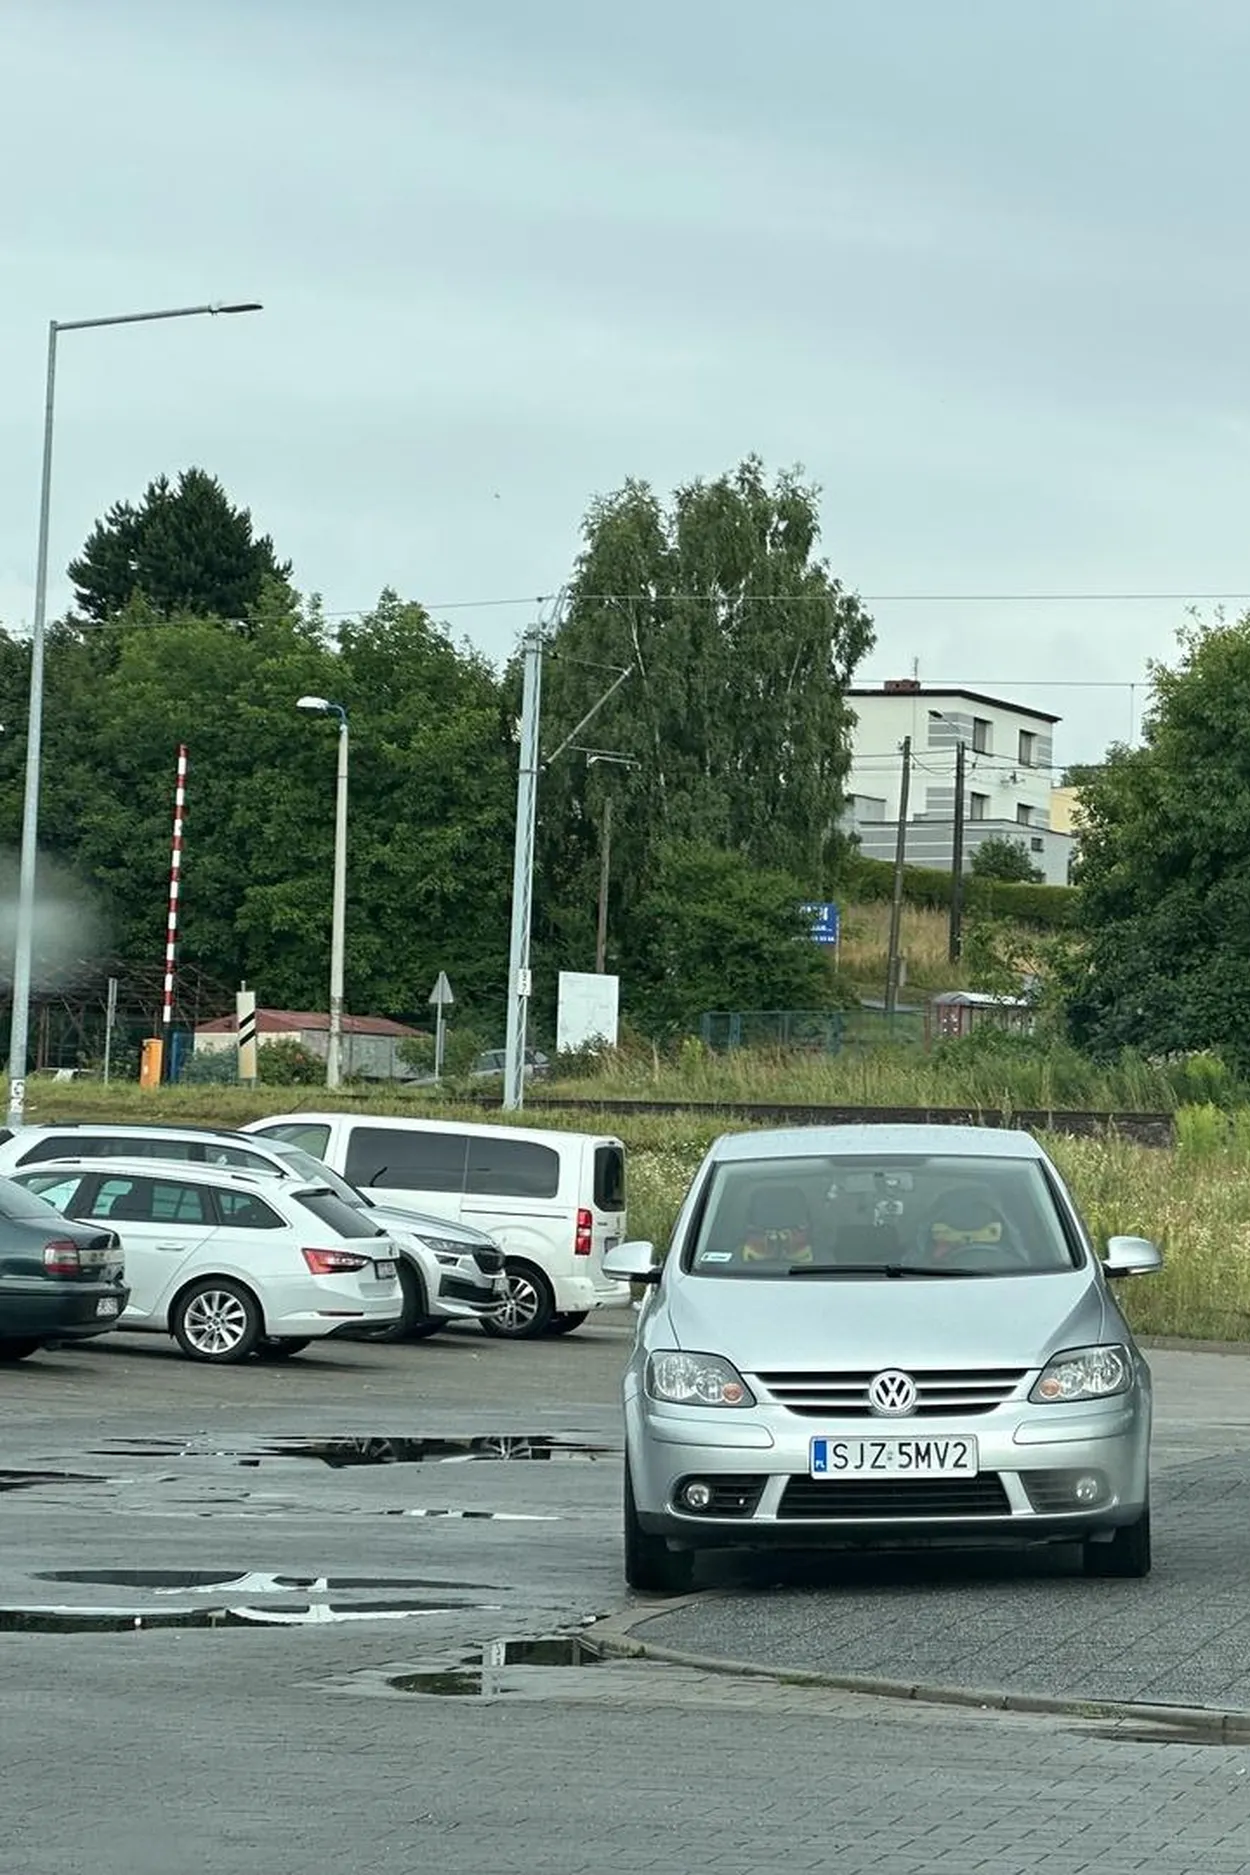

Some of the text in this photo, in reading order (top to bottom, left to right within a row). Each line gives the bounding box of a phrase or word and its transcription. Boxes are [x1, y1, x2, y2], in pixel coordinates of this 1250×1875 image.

[872, 1372, 914, 1413] VW
[832, 1441, 968, 1470] SJZ 5MV2
